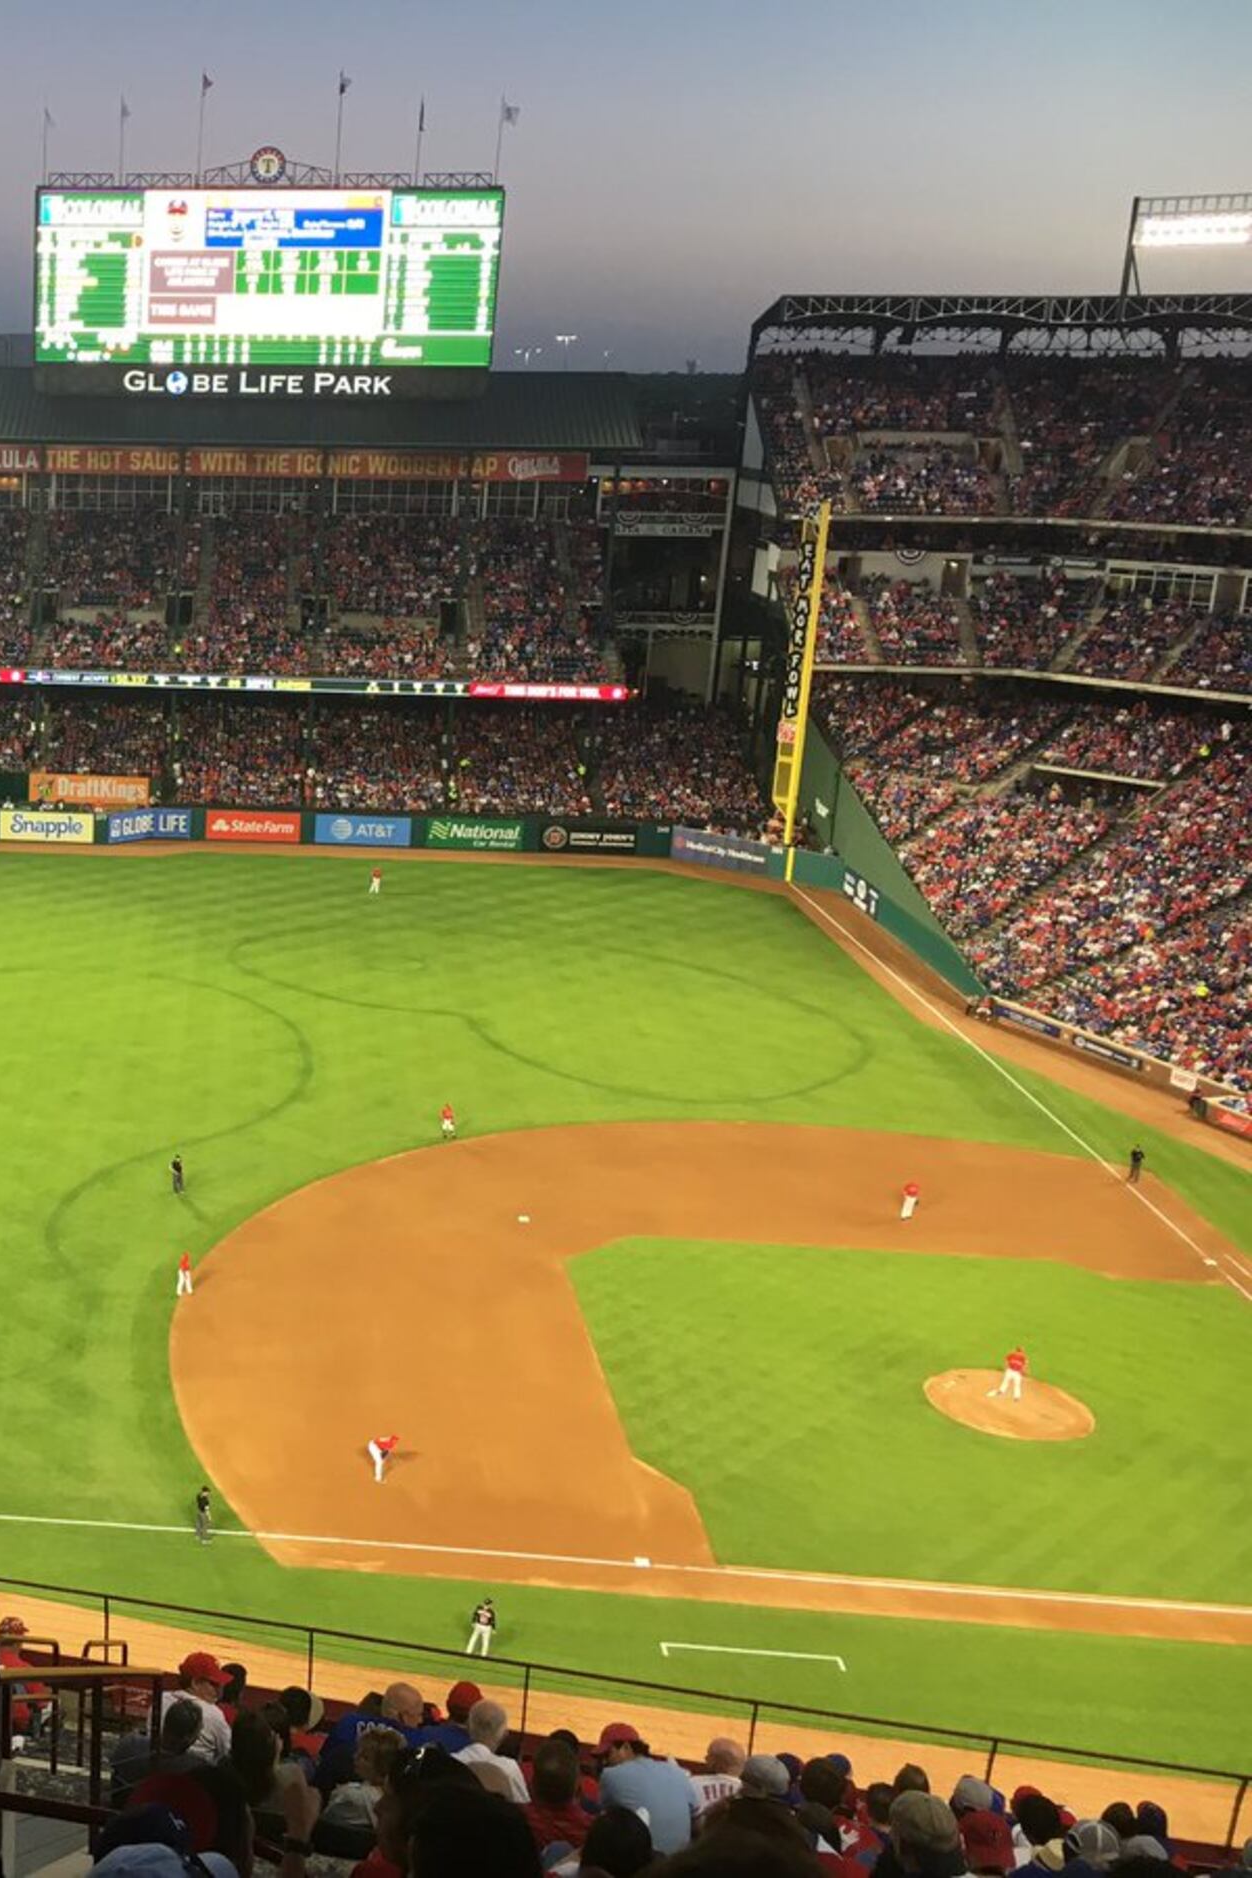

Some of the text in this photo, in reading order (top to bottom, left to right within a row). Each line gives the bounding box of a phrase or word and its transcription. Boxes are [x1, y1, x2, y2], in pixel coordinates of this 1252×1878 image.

[123, 369, 393, 396] GLOBE LIFE PARK
[47, 449, 79, 471] THE
[87, 450, 122, 471] HOT
[201, 452, 246, 473] WITH
[253, 453, 289, 474] THE
[368, 454, 449, 477] WOODEN
[801, 542, 815, 592] EAT
[793, 597, 809, 648] MOR
[785, 652, 801, 719] FOWL
[58, 776, 147, 801] DraftKings
[10, 813, 84, 838] Snapple
[122, 813, 188, 836] GLOBE LIFE
[355, 823, 397, 838] AT&T
[450, 822, 521, 840] National
